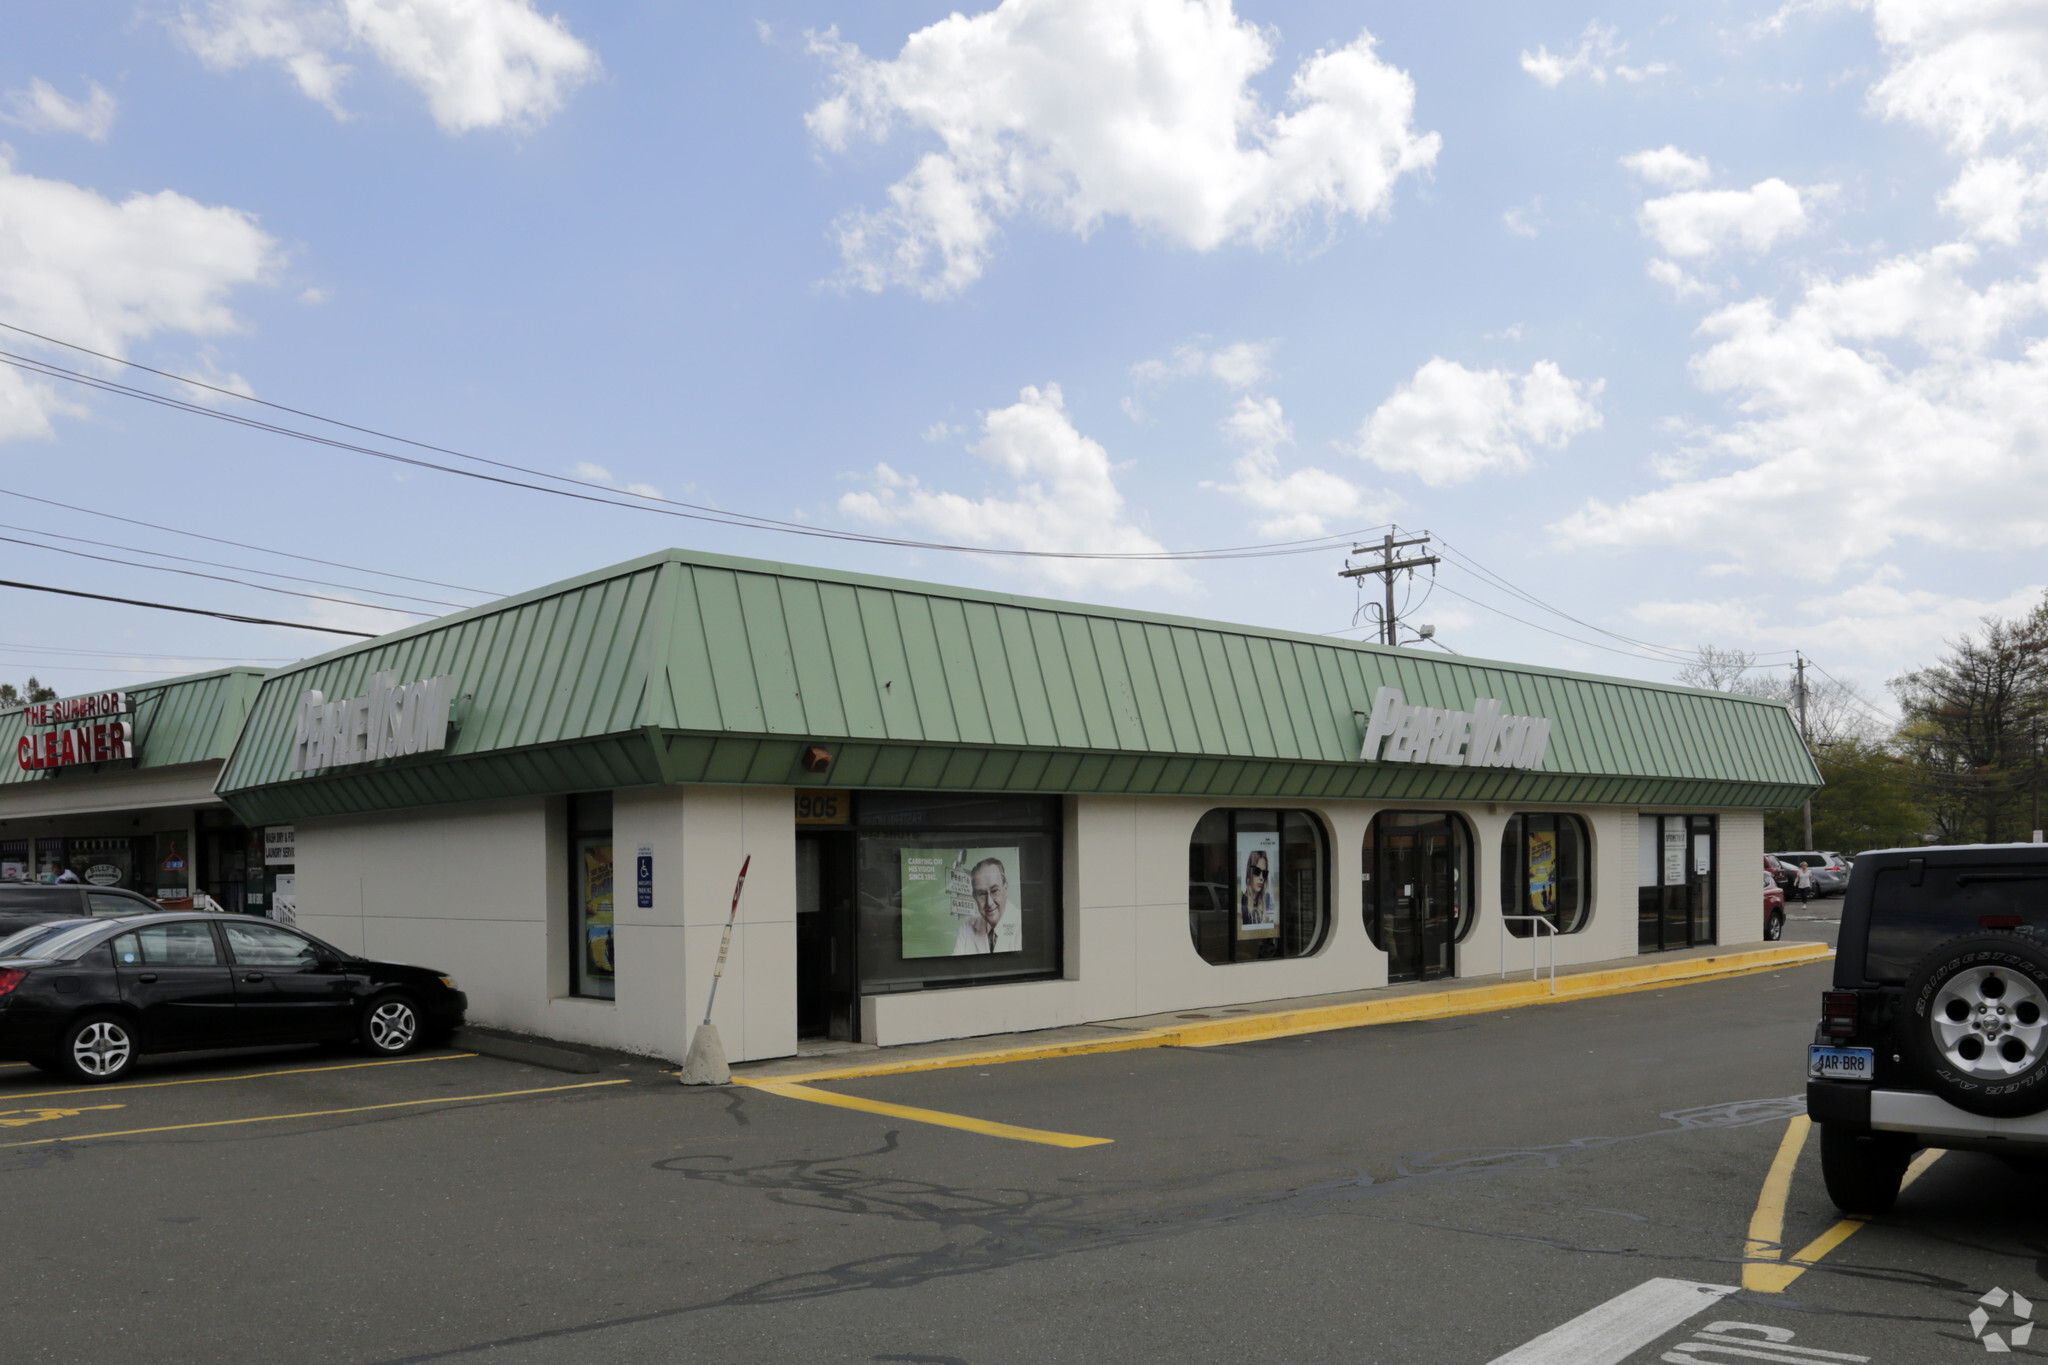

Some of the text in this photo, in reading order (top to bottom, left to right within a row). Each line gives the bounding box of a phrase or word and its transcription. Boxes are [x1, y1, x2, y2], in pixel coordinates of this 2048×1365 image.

[24, 692, 125, 727] THE SUPERIOR
[18, 721, 131, 771] CLEANER
[907, 857, 933, 865] CARRYING
